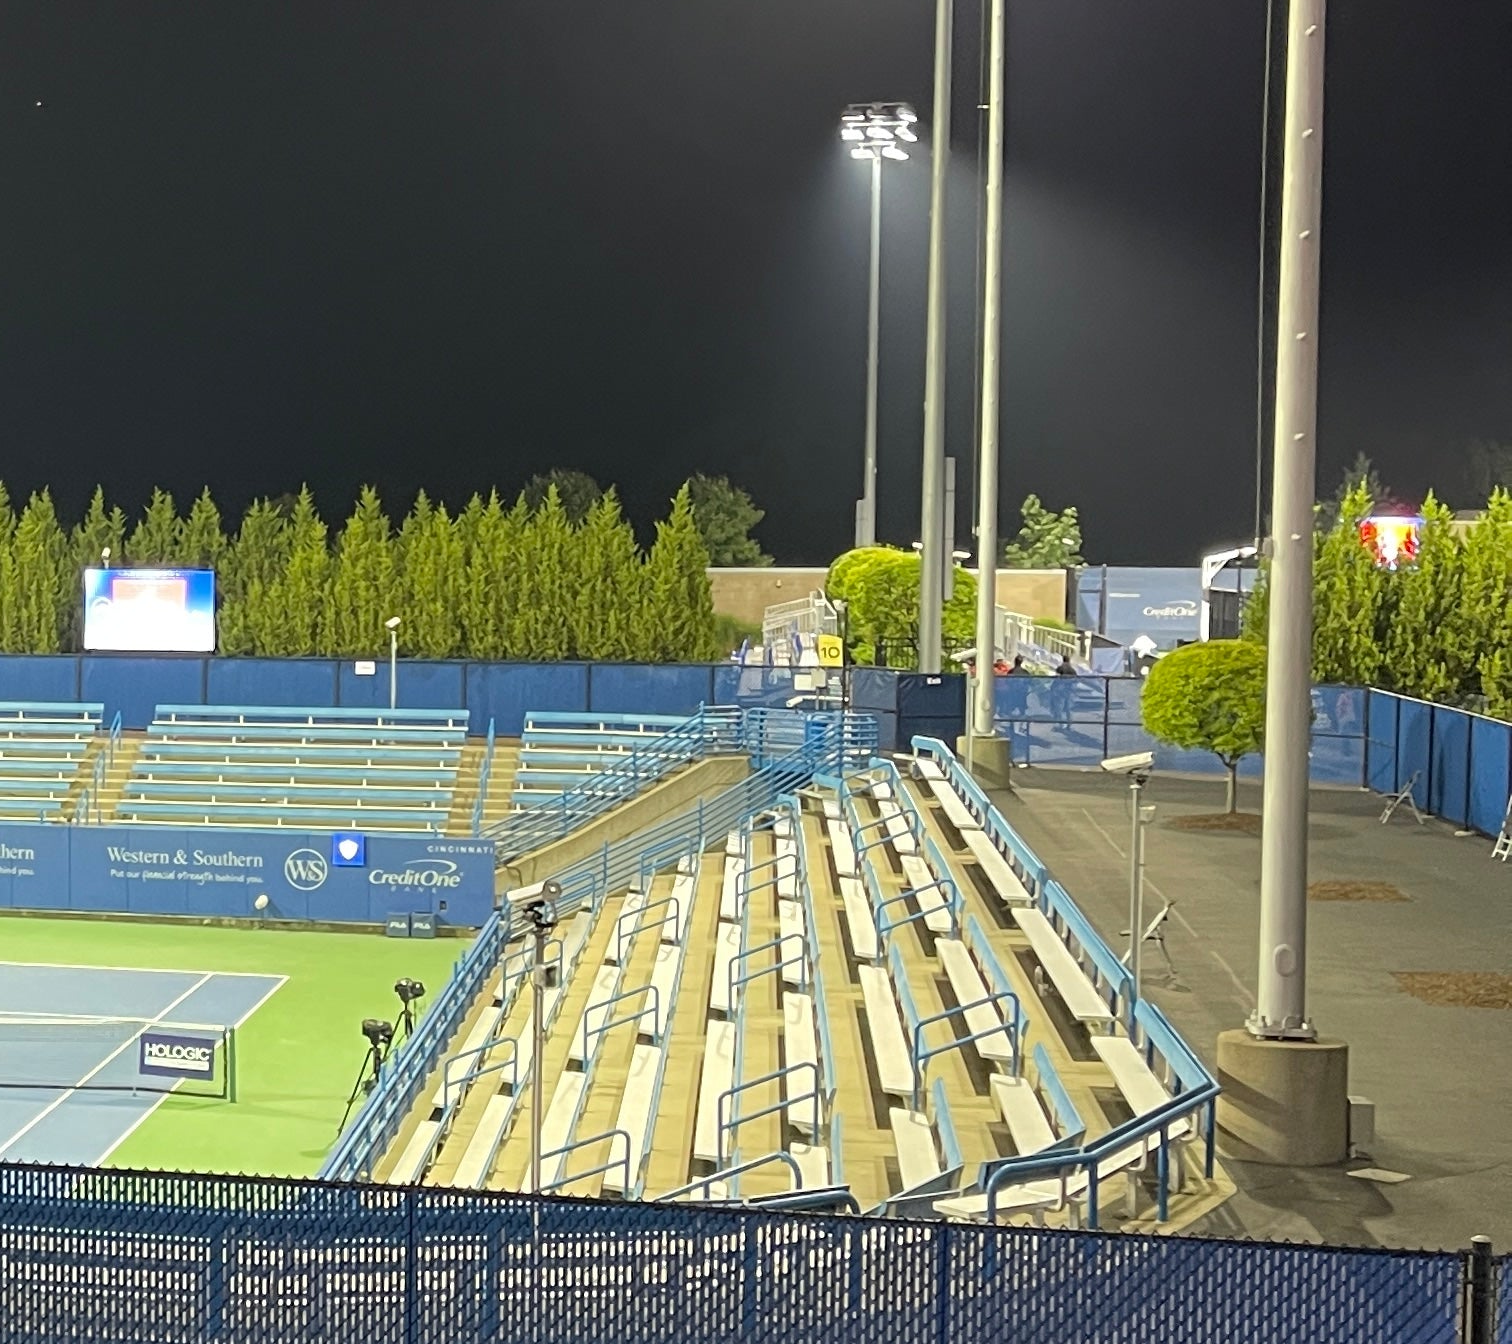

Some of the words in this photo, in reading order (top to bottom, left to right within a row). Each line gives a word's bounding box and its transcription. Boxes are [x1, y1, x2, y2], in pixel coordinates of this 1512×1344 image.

[820, 646, 840, 659] 10
[106, 846, 169, 864] Western
[173, 849, 189, 865] &
[192, 849, 263, 868] Southern
[426, 845, 494, 854] CINCINNATI
[369, 869, 461, 888] CreditOne
[144, 1042, 210, 1061] HOLOGIC
